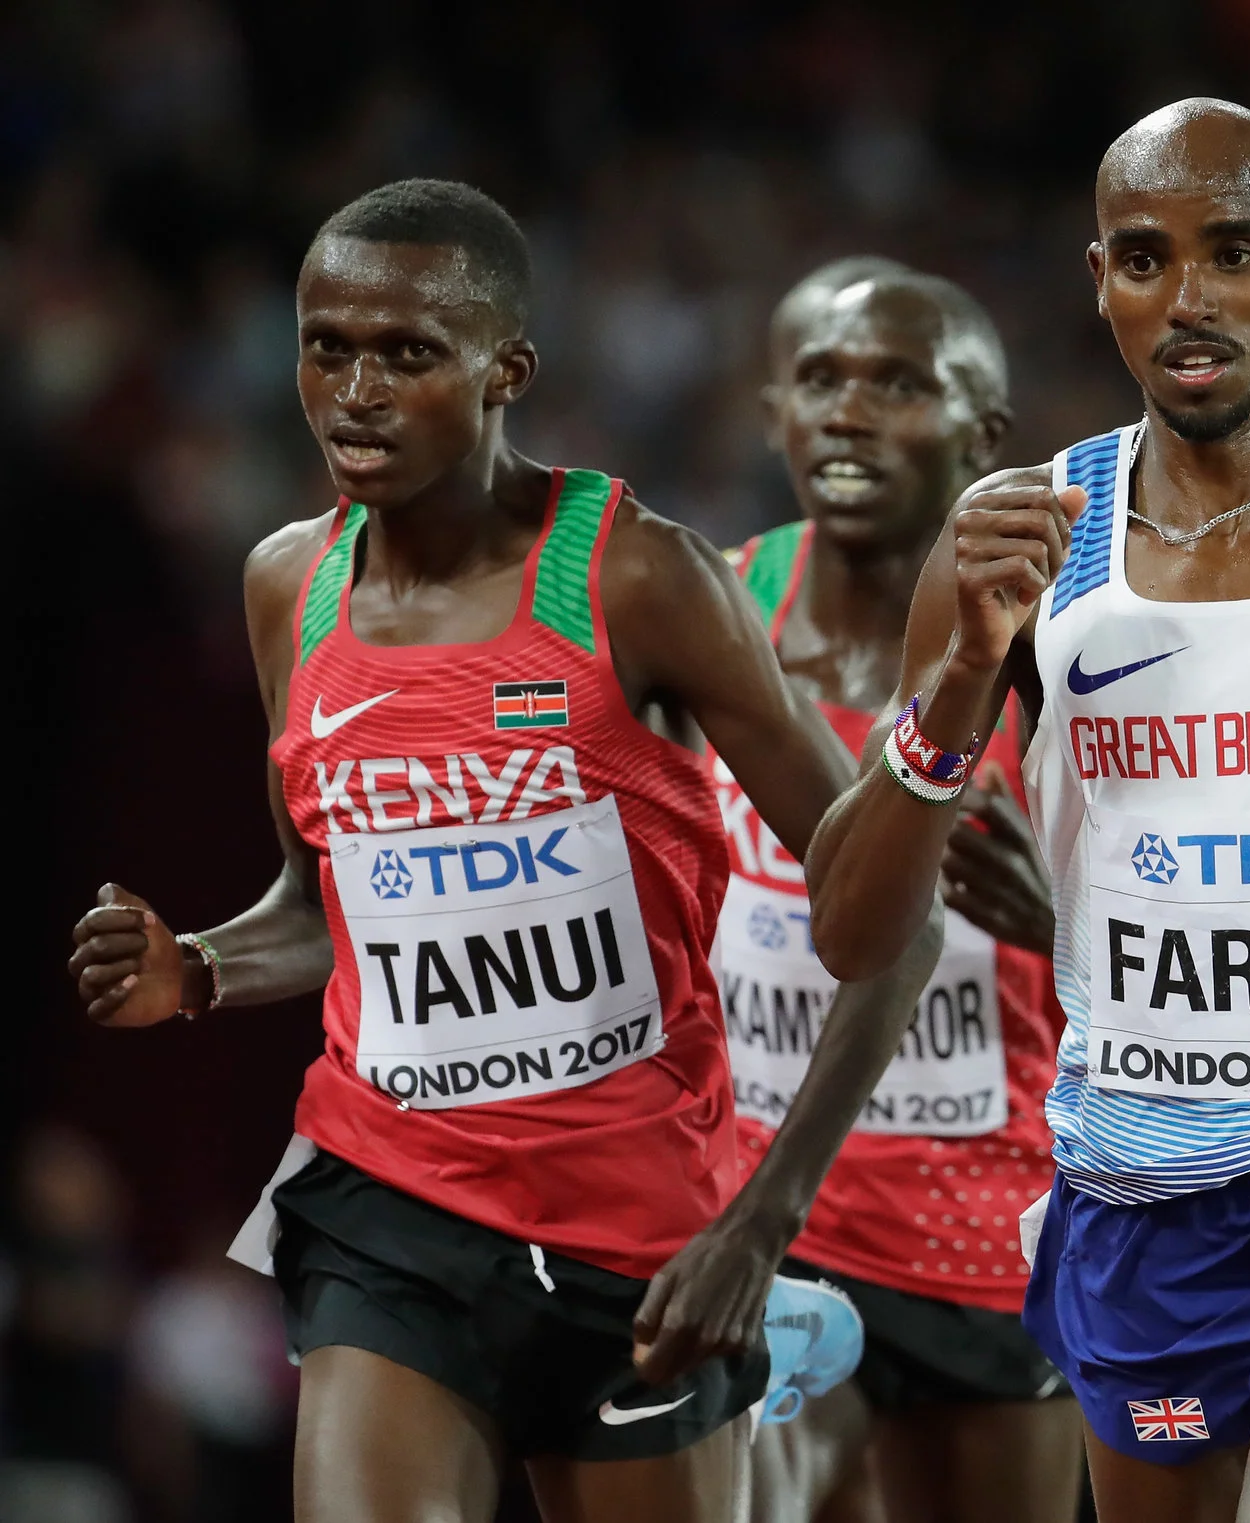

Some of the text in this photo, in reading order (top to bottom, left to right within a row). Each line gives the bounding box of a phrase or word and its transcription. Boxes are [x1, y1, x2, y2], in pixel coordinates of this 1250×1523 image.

[314, 745, 587, 834] KENYA
[1068, 714, 1207, 780] GREAT
[408, 825, 583, 896] TDK
[366, 907, 627, 1026] TANUI
[369, 1013, 653, 1100] LONDON 2017
[722, 970, 986, 1061] KAMROR
[906, 1088, 994, 1123] 2017
